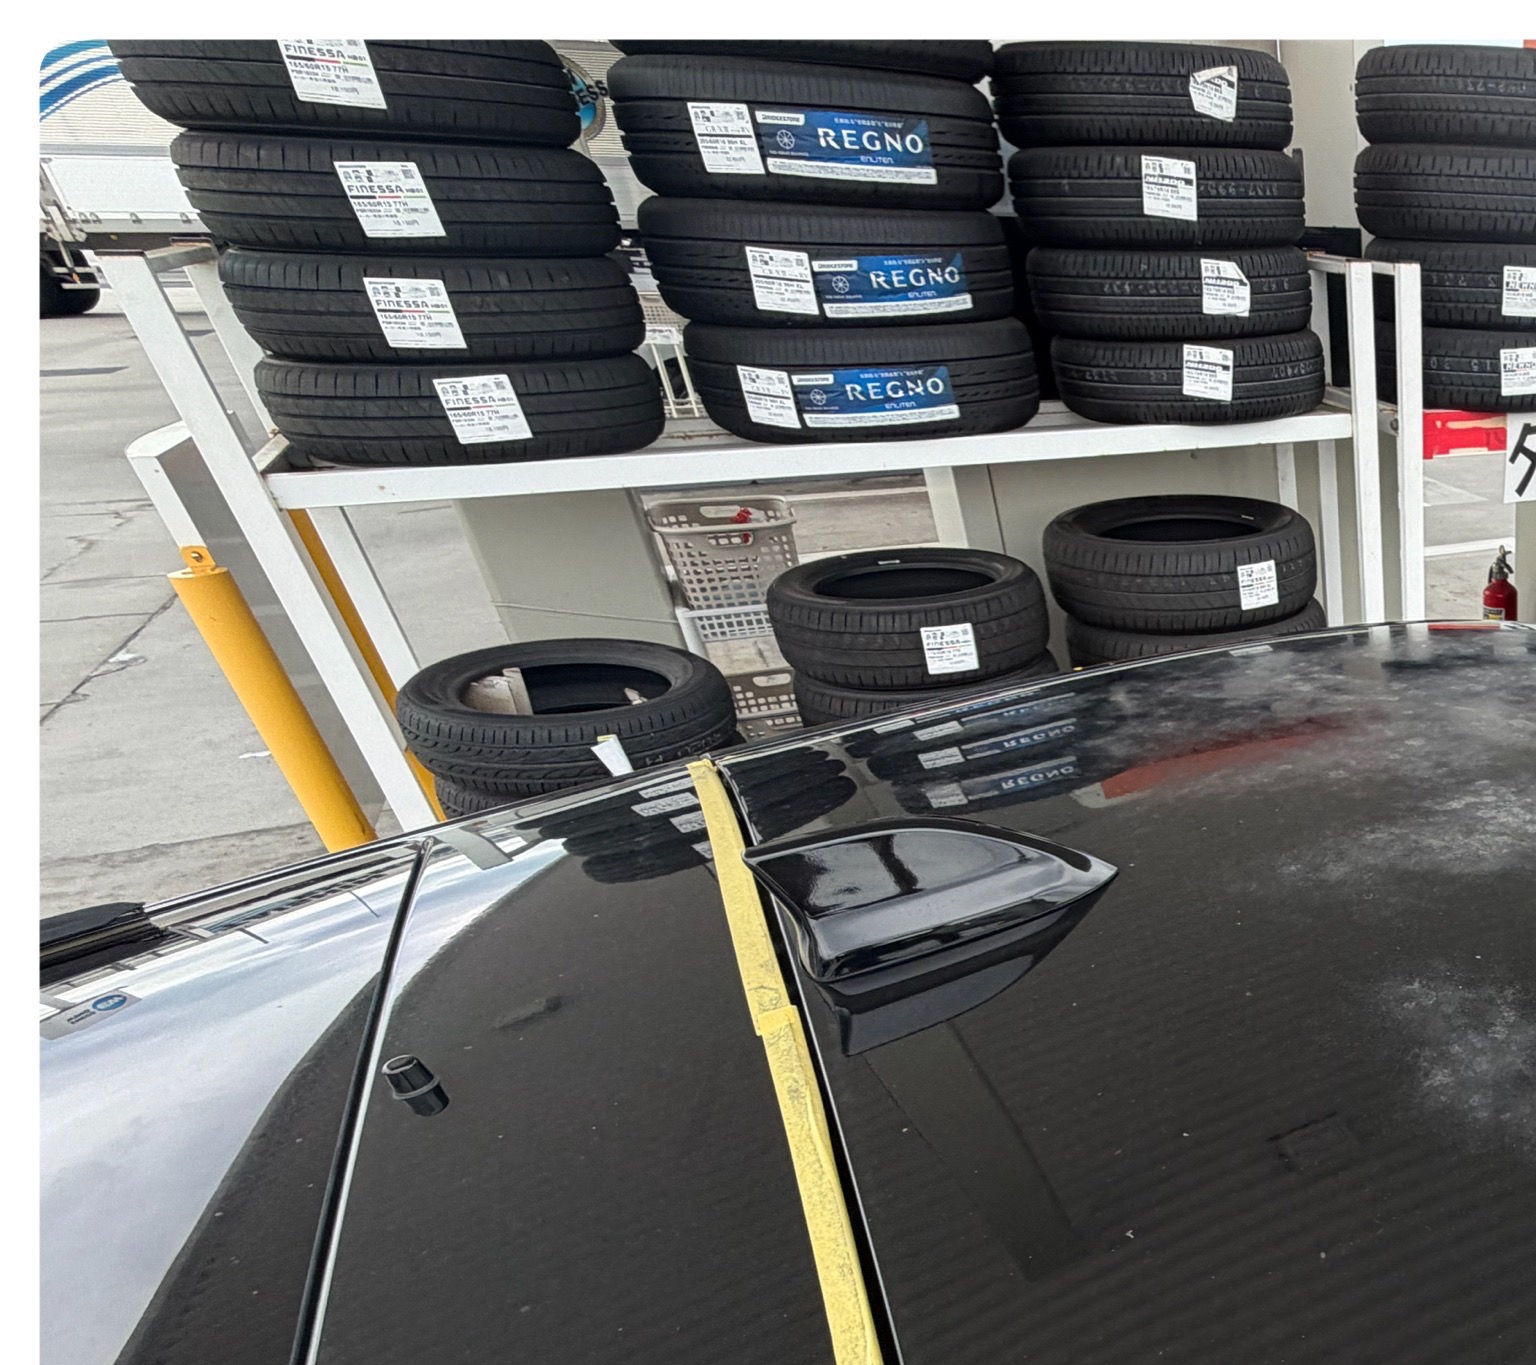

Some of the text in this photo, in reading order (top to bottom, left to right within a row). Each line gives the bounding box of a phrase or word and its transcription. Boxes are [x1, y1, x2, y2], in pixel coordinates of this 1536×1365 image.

[284, 44, 345, 59] FINESSA
[761, 113, 801, 123] BRIDGESTONE
[817, 127, 925, 154] REGNO
[347, 185, 405, 194] FINESSA
[868, 265, 961, 289] REGNO
[375, 299, 430, 309] FINESSA
[845, 377, 944, 401] REGNO
[445, 396, 497, 406] FINESSA
